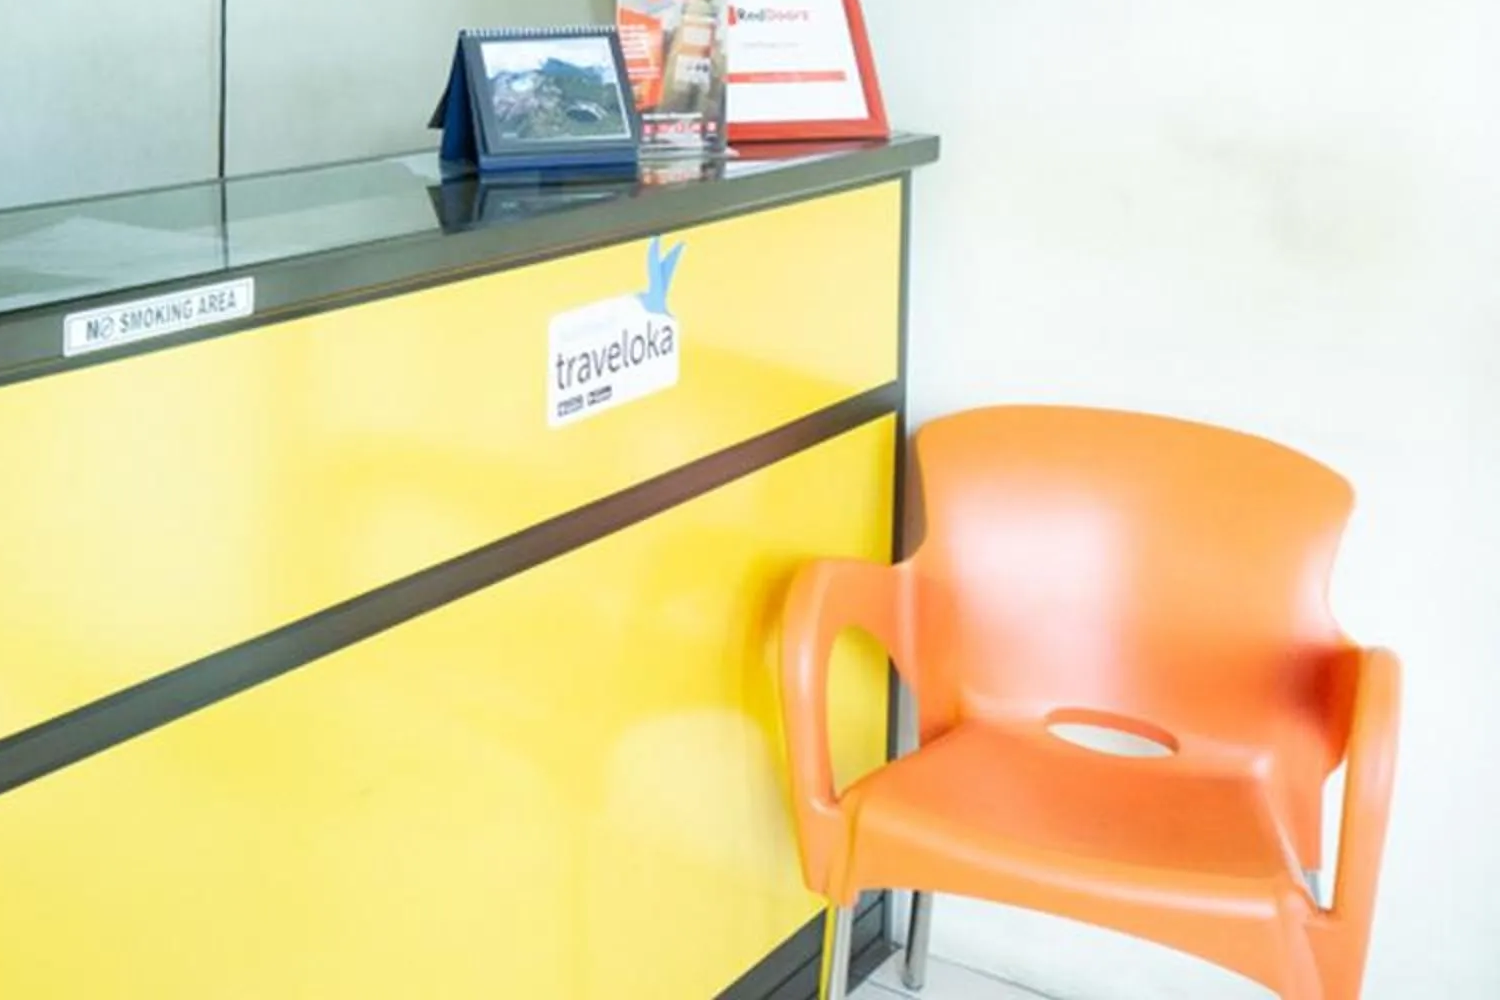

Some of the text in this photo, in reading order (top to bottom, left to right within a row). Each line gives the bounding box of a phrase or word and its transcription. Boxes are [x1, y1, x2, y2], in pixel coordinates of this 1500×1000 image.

[119, 301, 193, 333] SMOKING
[198, 290, 236, 316] AREA
[556, 320, 674, 391] traveloka
